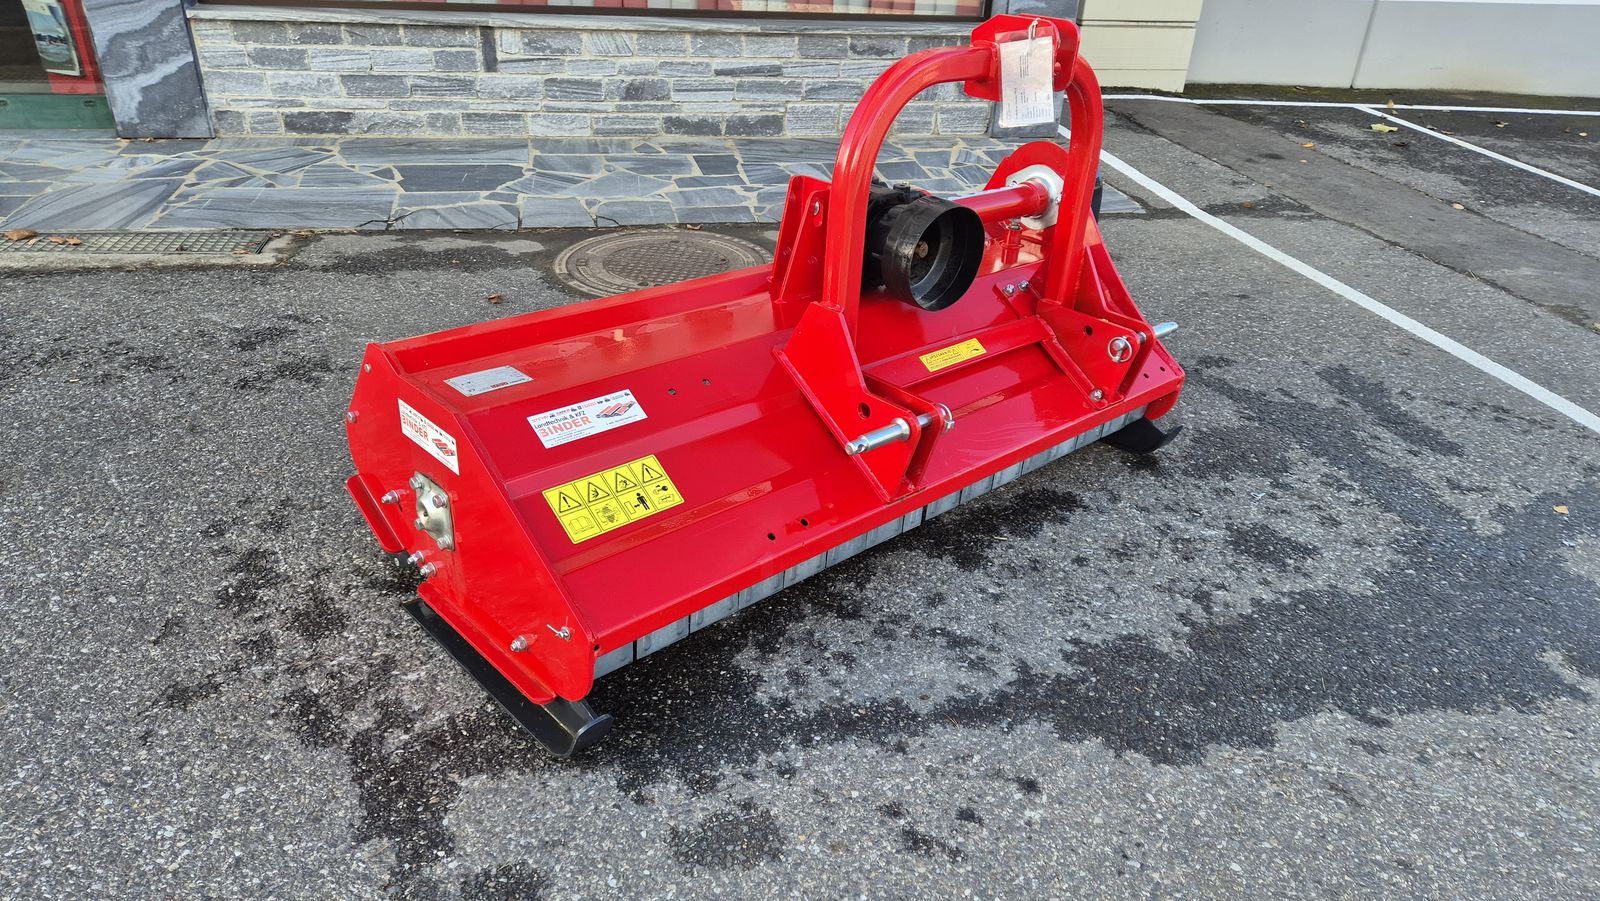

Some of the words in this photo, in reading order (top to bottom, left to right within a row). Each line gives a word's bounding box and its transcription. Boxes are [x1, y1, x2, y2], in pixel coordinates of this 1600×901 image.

[402, 414, 429, 441] BINDER
[534, 416, 568, 429] Landtechnik
[575, 410, 586, 418] KFZ
[538, 416, 592, 438] BINDER
